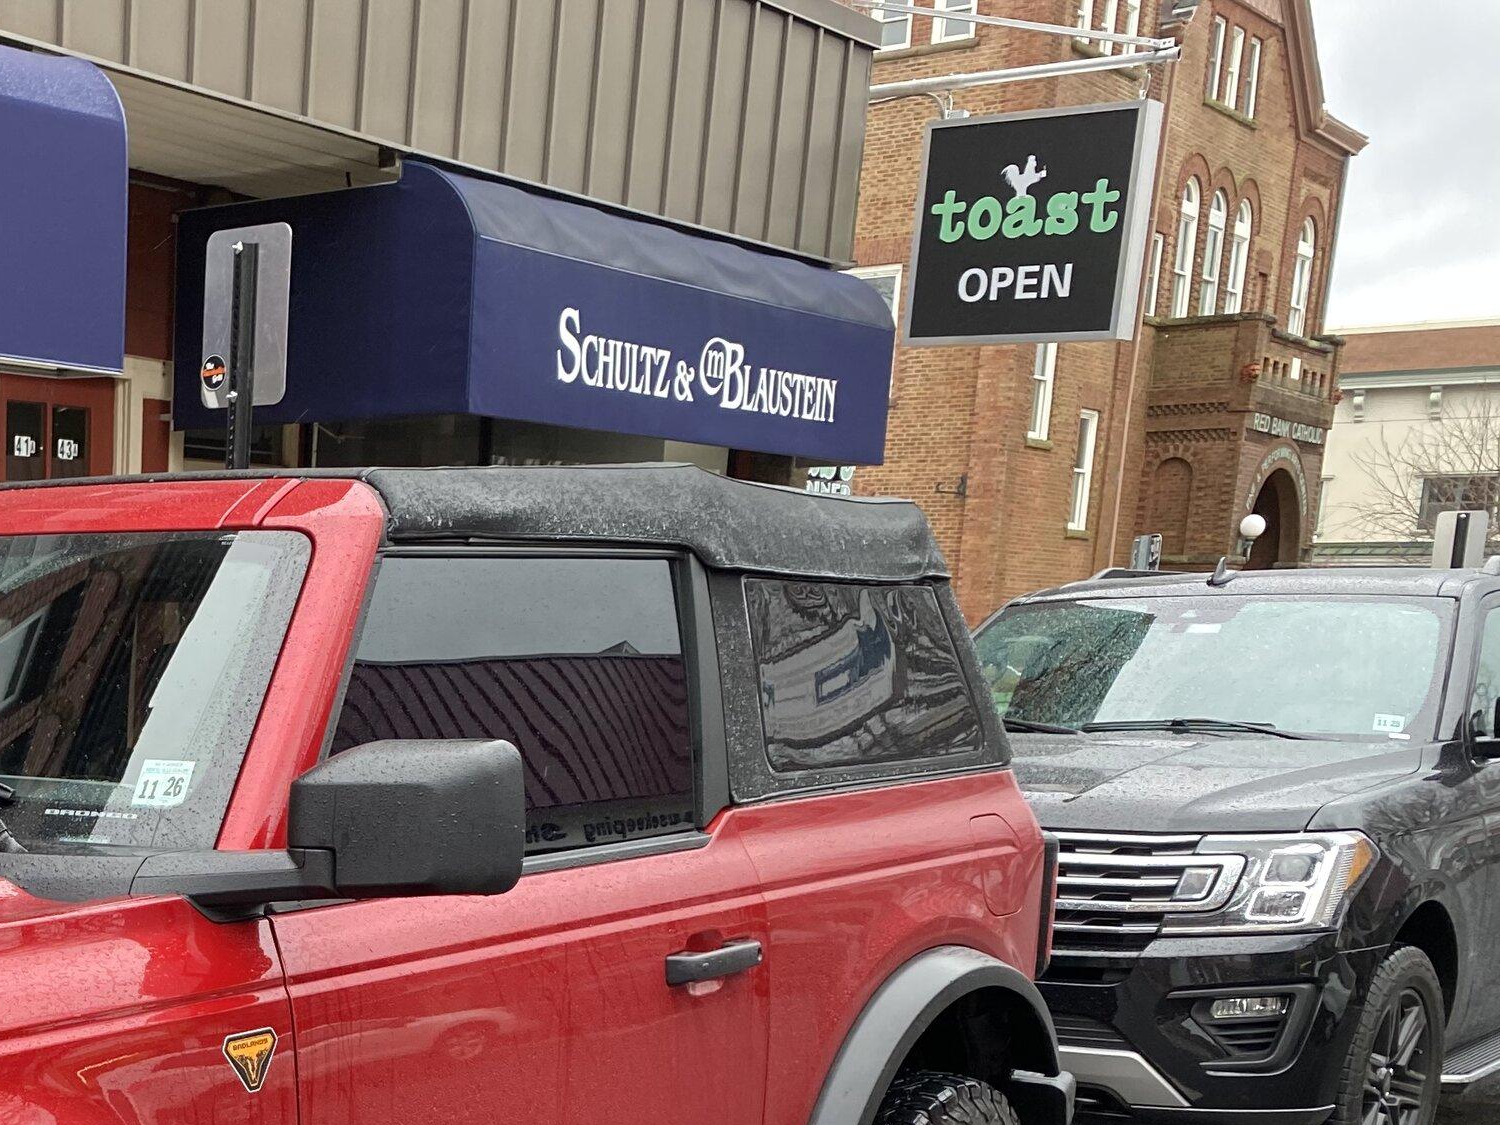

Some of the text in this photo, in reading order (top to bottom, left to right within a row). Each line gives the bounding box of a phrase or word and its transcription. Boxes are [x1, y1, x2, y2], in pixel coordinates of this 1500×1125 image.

[931, 178, 1120, 243] toast
[958, 263, 1073, 302] OPEN
[557, 307, 671, 398] SCHULTZ
[674, 360, 695, 401] &
[1253, 412, 1322, 444] RED BANK CATHOLIC
[138, 776, 185, 800] 11 26
